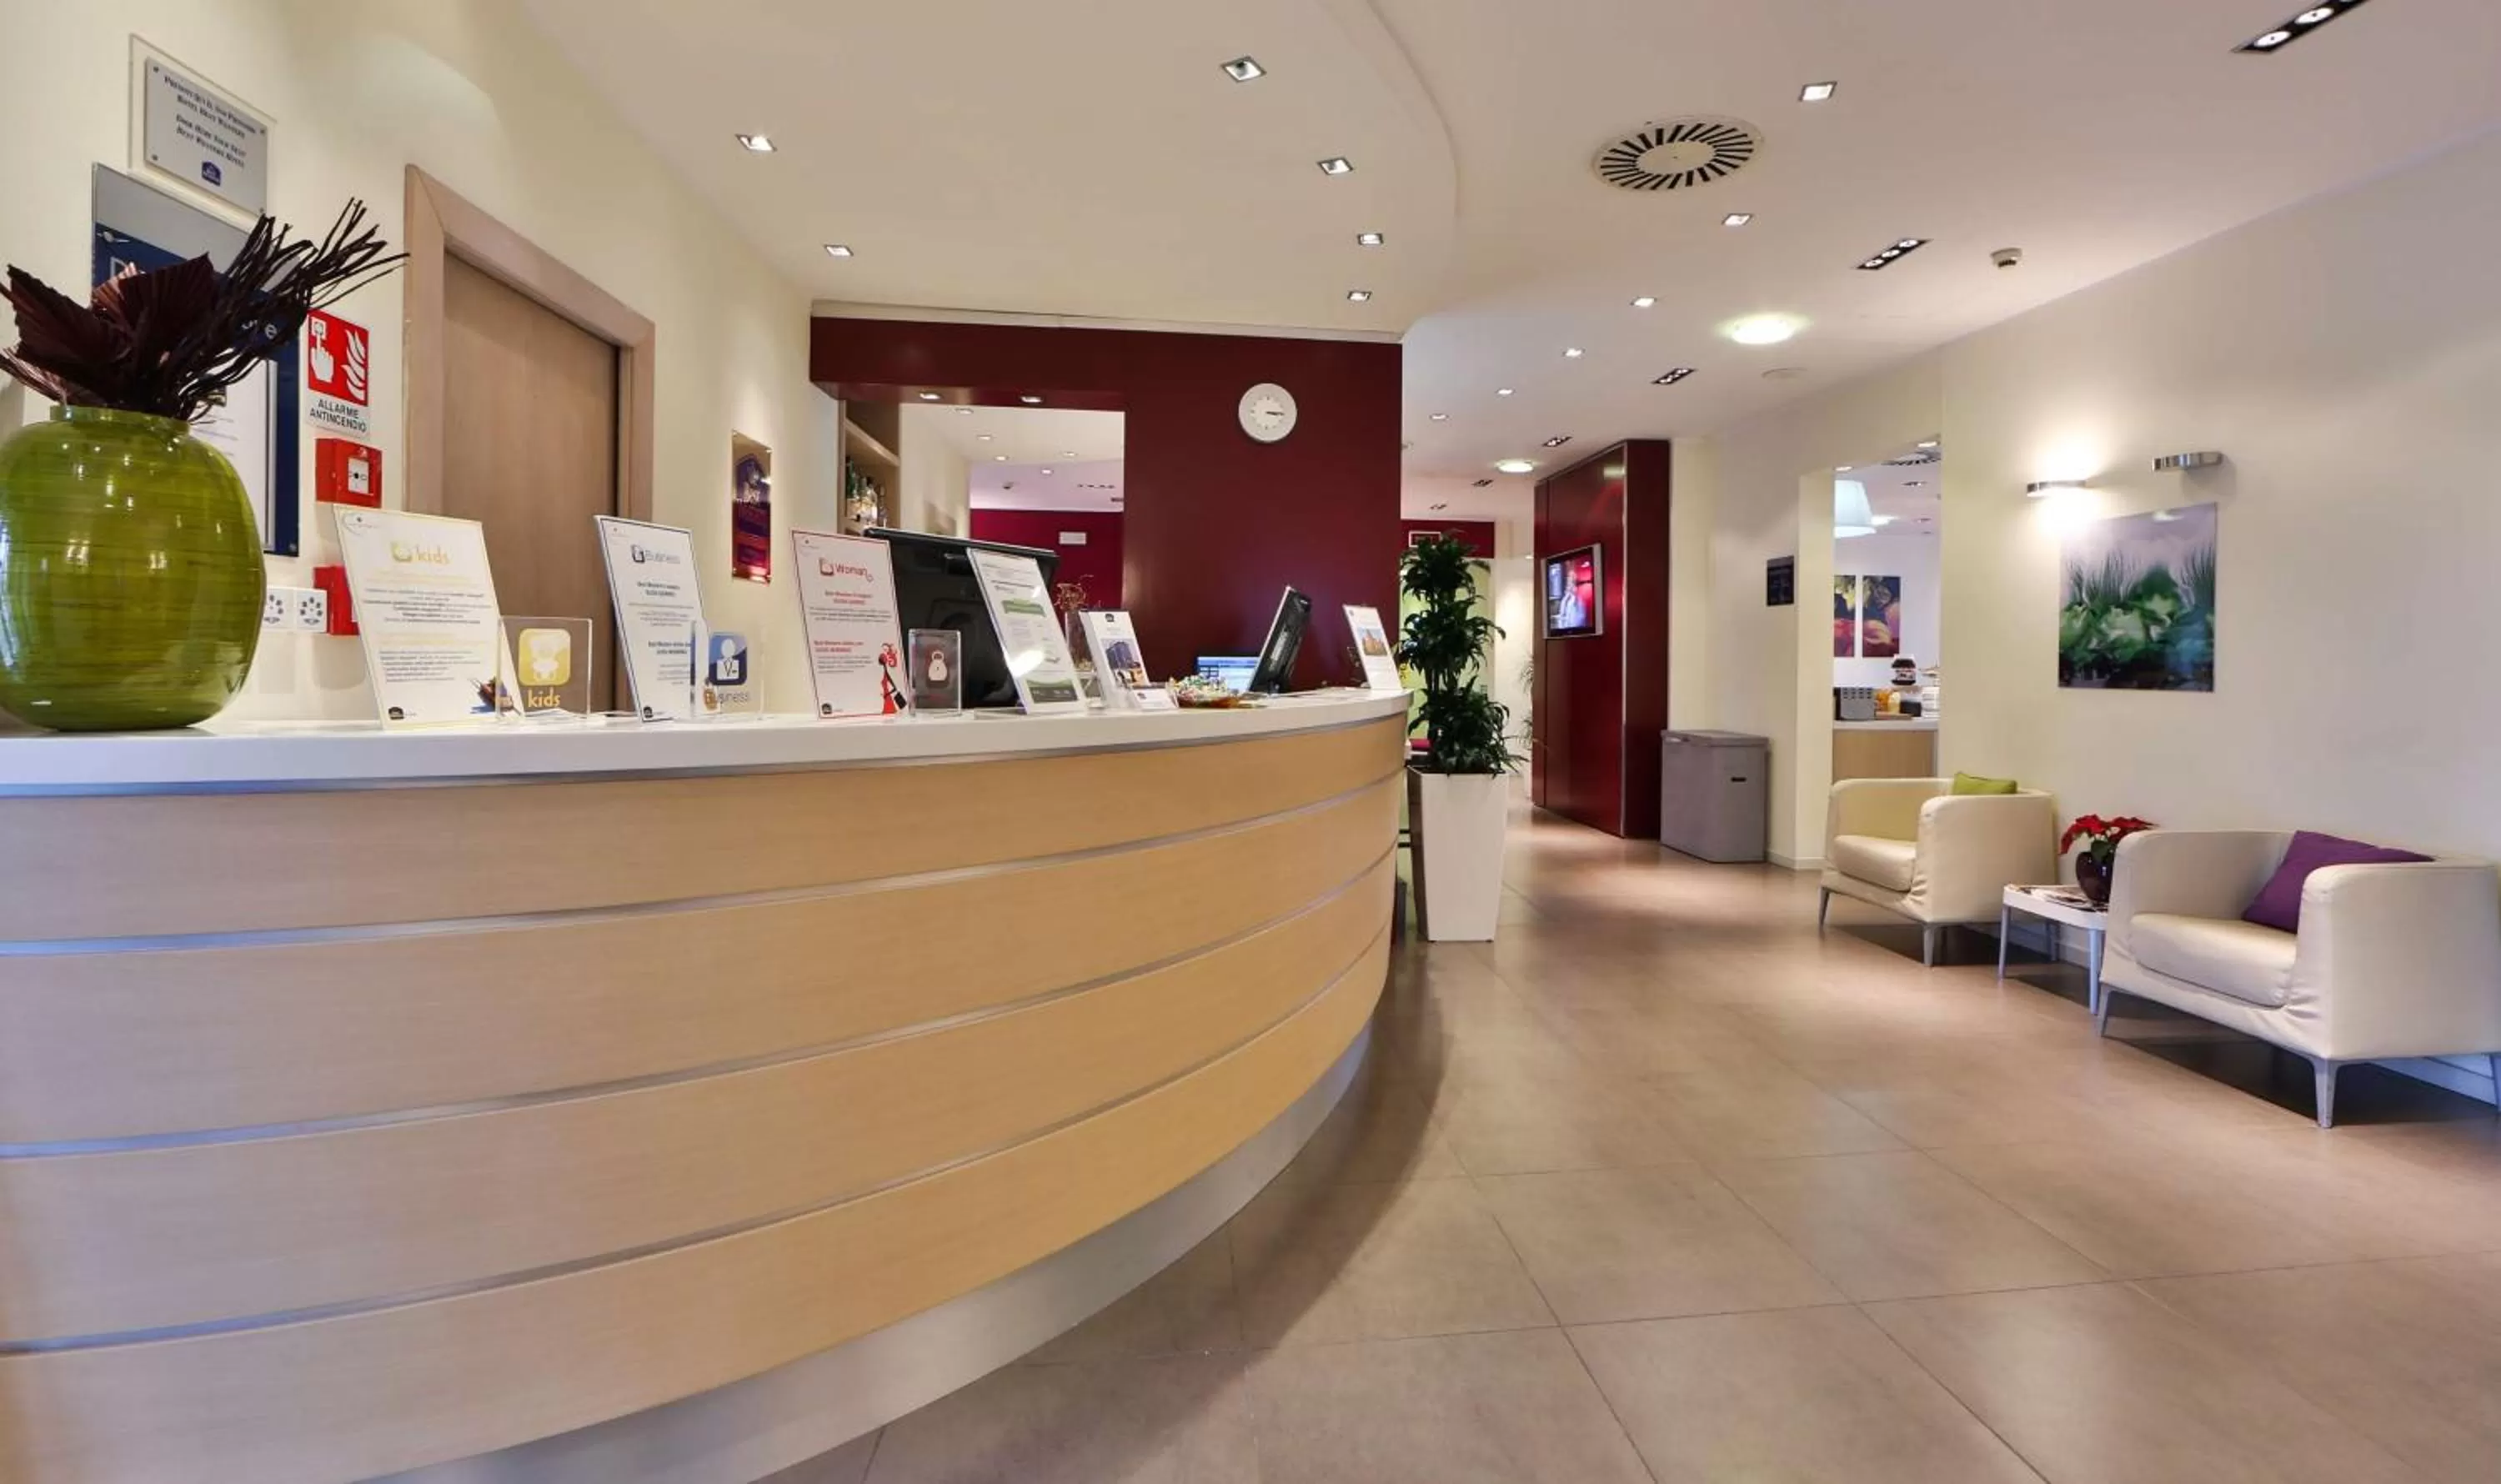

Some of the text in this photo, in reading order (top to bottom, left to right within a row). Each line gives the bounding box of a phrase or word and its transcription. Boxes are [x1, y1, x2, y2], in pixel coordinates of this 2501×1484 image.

[309, 407, 367, 433] ANTINCENDIO
[318, 399, 359, 419] ALLARME
[528, 686, 561, 708] kids
